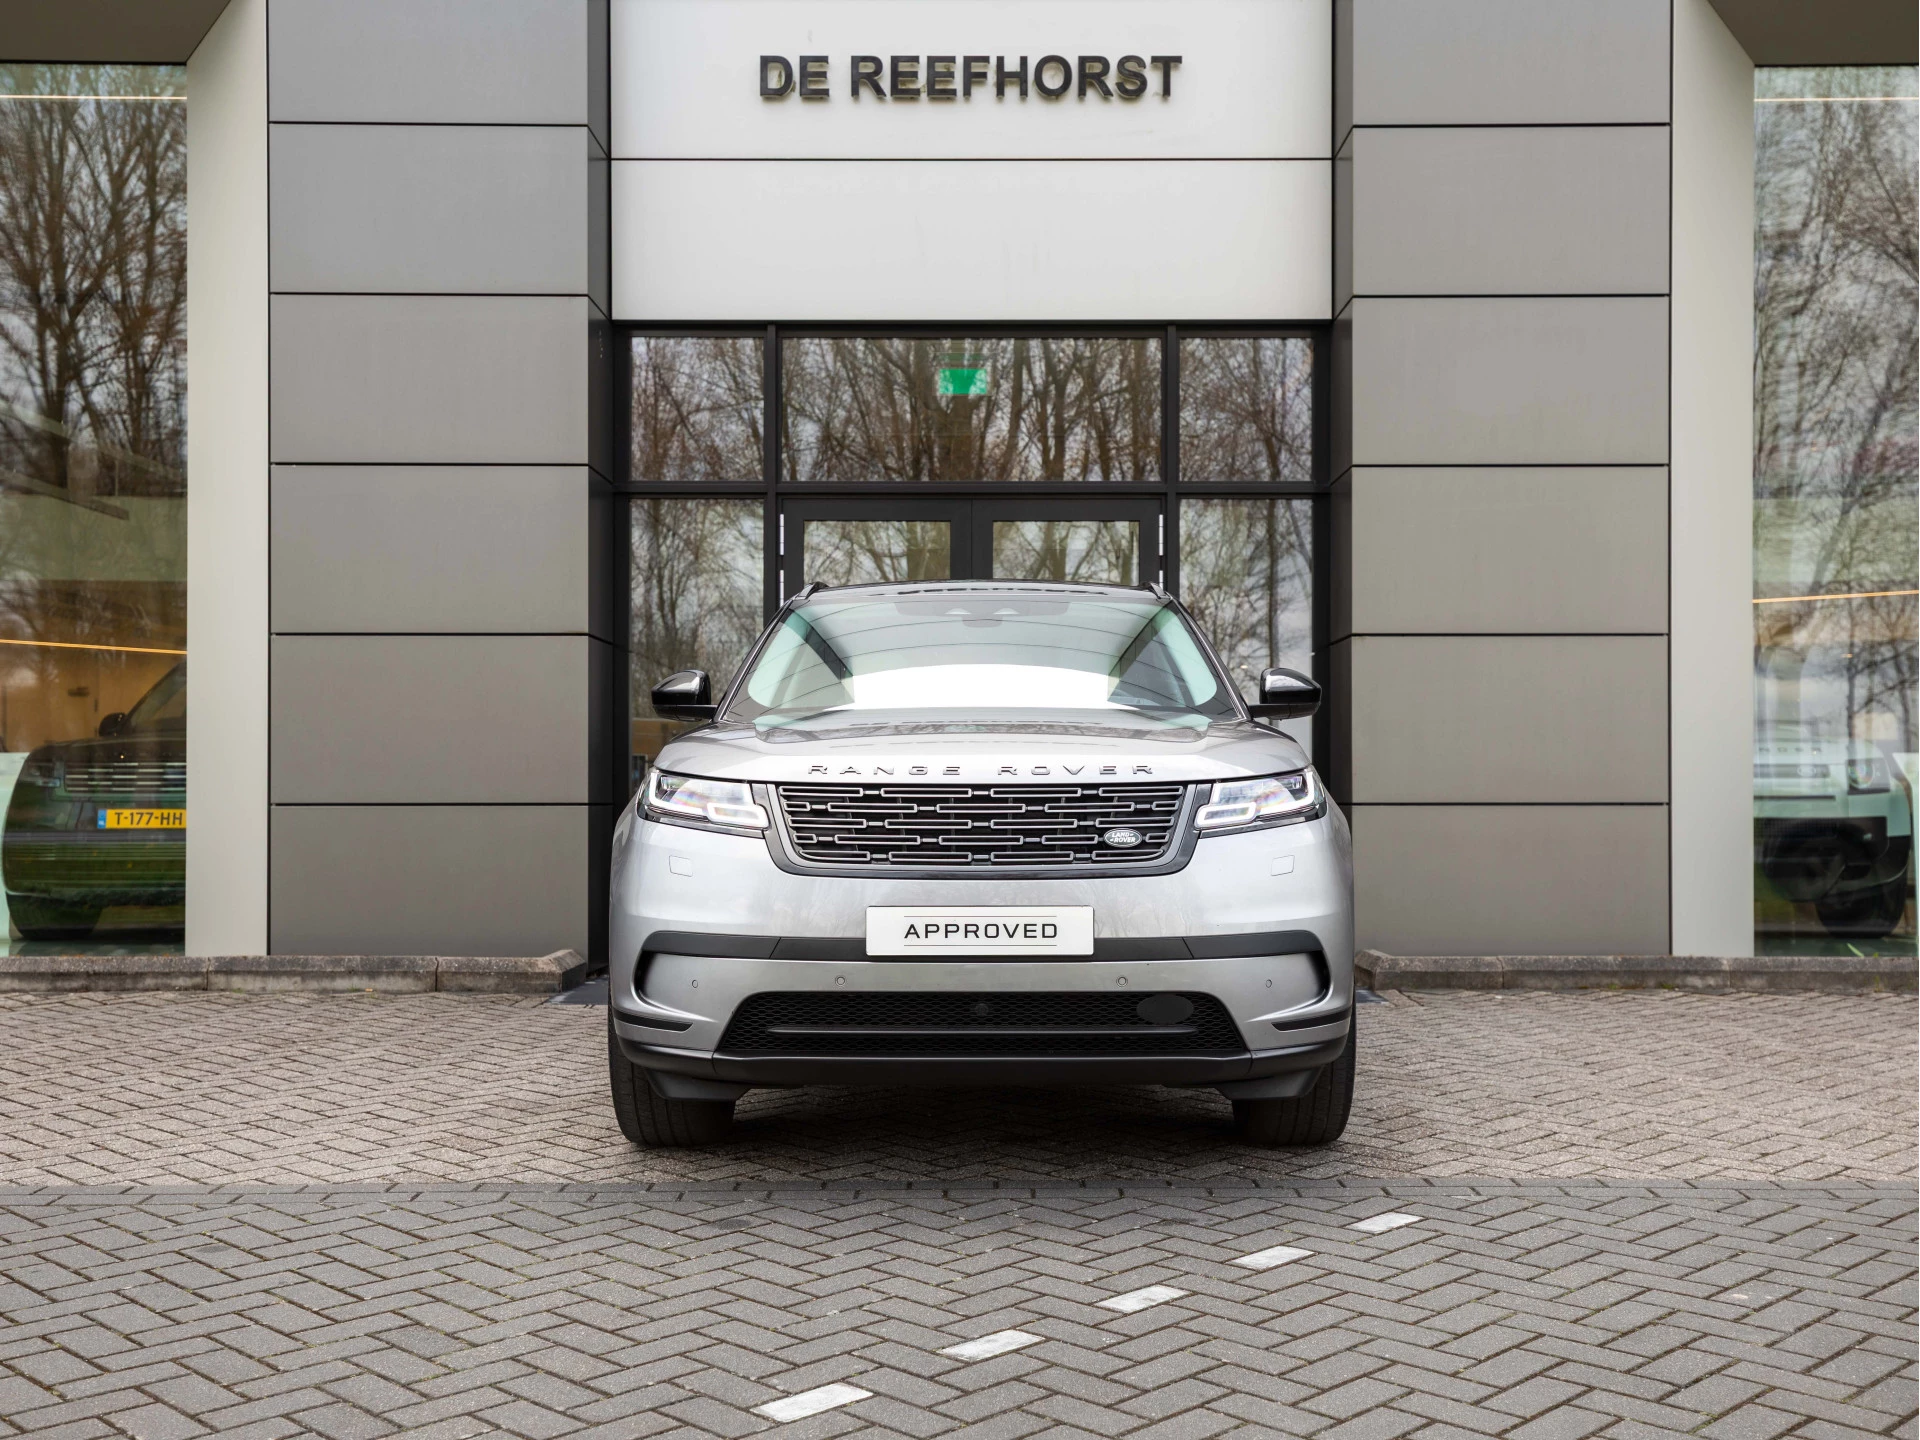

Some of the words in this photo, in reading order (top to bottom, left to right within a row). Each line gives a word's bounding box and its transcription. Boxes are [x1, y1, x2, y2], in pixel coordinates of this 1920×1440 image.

[760, 55, 830, 98] DE
[851, 54, 1183, 99] REEFHORST
[808, 765, 961, 776] RANGE
[997, 765, 1154, 776] ROVER
[114, 811, 183, 826] T-177-HH
[904, 923, 1058, 939] APPROVED
